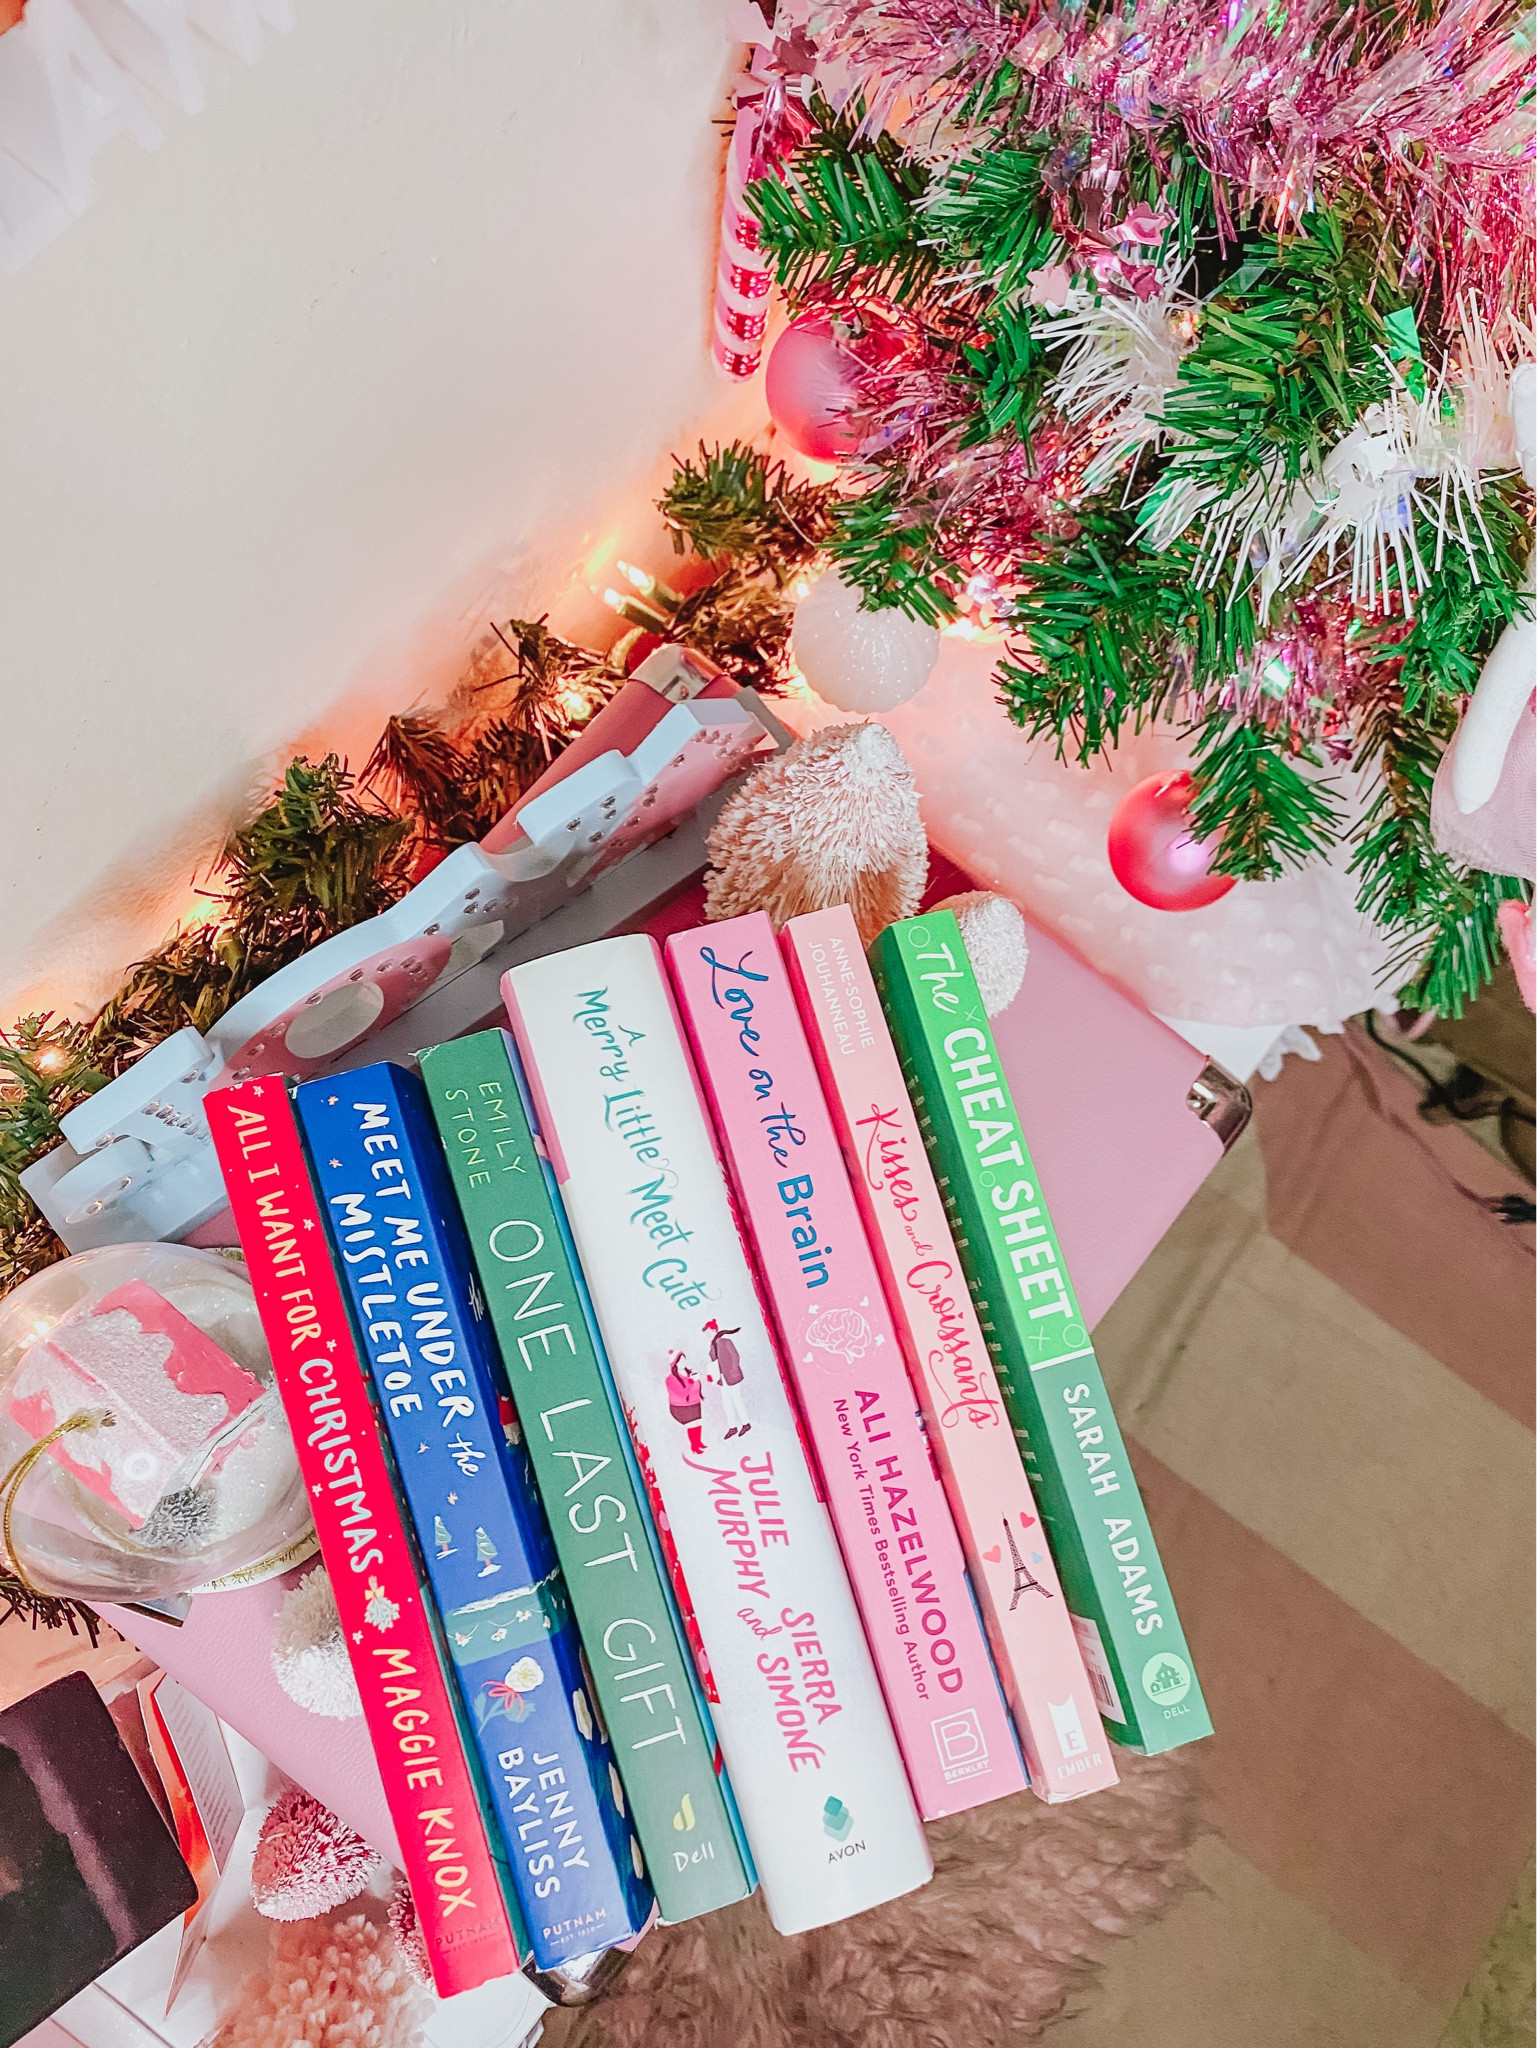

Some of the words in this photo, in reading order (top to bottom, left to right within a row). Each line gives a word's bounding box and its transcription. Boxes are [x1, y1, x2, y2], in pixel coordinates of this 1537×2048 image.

[573, 986, 630, 1082] Merry
[618, 1024, 647, 1048] A
[700, 946, 769, 1057] Love
[808, 941, 856, 1056] JOUHANNEAU
[829, 936, 876, 1049] ANNE-SOPHIE
[227, 1104, 271, 1160] ALL
[478, 1081, 527, 1174] EMILY
[603, 1089, 671, 1176] Little
[748, 1068, 774, 1101] on
[915, 942, 967, 1015] The
[942, 1026, 1025, 1169] CHEAT
[991, 1180, 1074, 1321] SHEET
[247, 1167, 280, 1184] I
[445, 1088, 491, 1188] STONE
[760, 1101, 807, 1169] the
[856, 1102, 919, 1222] Kisses
[256, 1190, 306, 1278] WANT
[627, 1173, 694, 1250] Meet
[776, 1173, 834, 1290] Brain
[903, 1224, 935, 1257] and
[281, 1289, 322, 1351] FOR
[330, 1193, 423, 1418] MISTLETOE
[353, 1101, 411, 1200] MEET
[383, 1215, 429, 1271] ME
[406, 1281, 476, 1428] UNDER
[447, 1432, 486, 1477] the
[642, 1257, 717, 1311] Cute
[906, 1260, 1000, 1430] Croissants
[299, 1358, 384, 1573] CHRISTMAS
[489, 1219, 578, 1372] ONE
[539, 1398, 639, 1573] LAST
[602, 1618, 687, 1751] GIFT
[740, 1451, 790, 1548] JULIE
[1063, 1383, 1121, 1498] SARAH
[1102, 1516, 1163, 1637] ADAMS
[684, 1455, 771, 1600] MURPHY
[736, 1608, 783, 1642] and
[832, 1399, 853, 1435] New
[846, 1441, 867, 1480] York
[860, 1486, 881, 1536] Times
[875, 1540, 911, 1635] Bestselling
[905, 1640, 929, 1701] Author
[854, 1389, 891, 1444] ALI
[874, 1453, 964, 1694] HAZELWOOD
[757, 1653, 827, 1773] SIMONE
[780, 1607, 842, 1726] SIERRA
[1163, 1704, 1190, 1719] DELL
[372, 1647, 444, 1791] MAGGIE
[417, 1807, 476, 1918] KNOX
[940, 1721, 979, 1760] B
[944, 1759, 989, 1781] BERKLEY
[1057, 1754, 1103, 1780] EMBER
[497, 1746, 560, 1898] BAYLISS
[533, 1752, 589, 1869] JENNY
[672, 1842, 716, 1872] Dell
[828, 1840, 867, 1864] AVON
[435, 1917, 500, 1949] PUTNAM
[542, 1907, 606, 1940] PUTNAM
